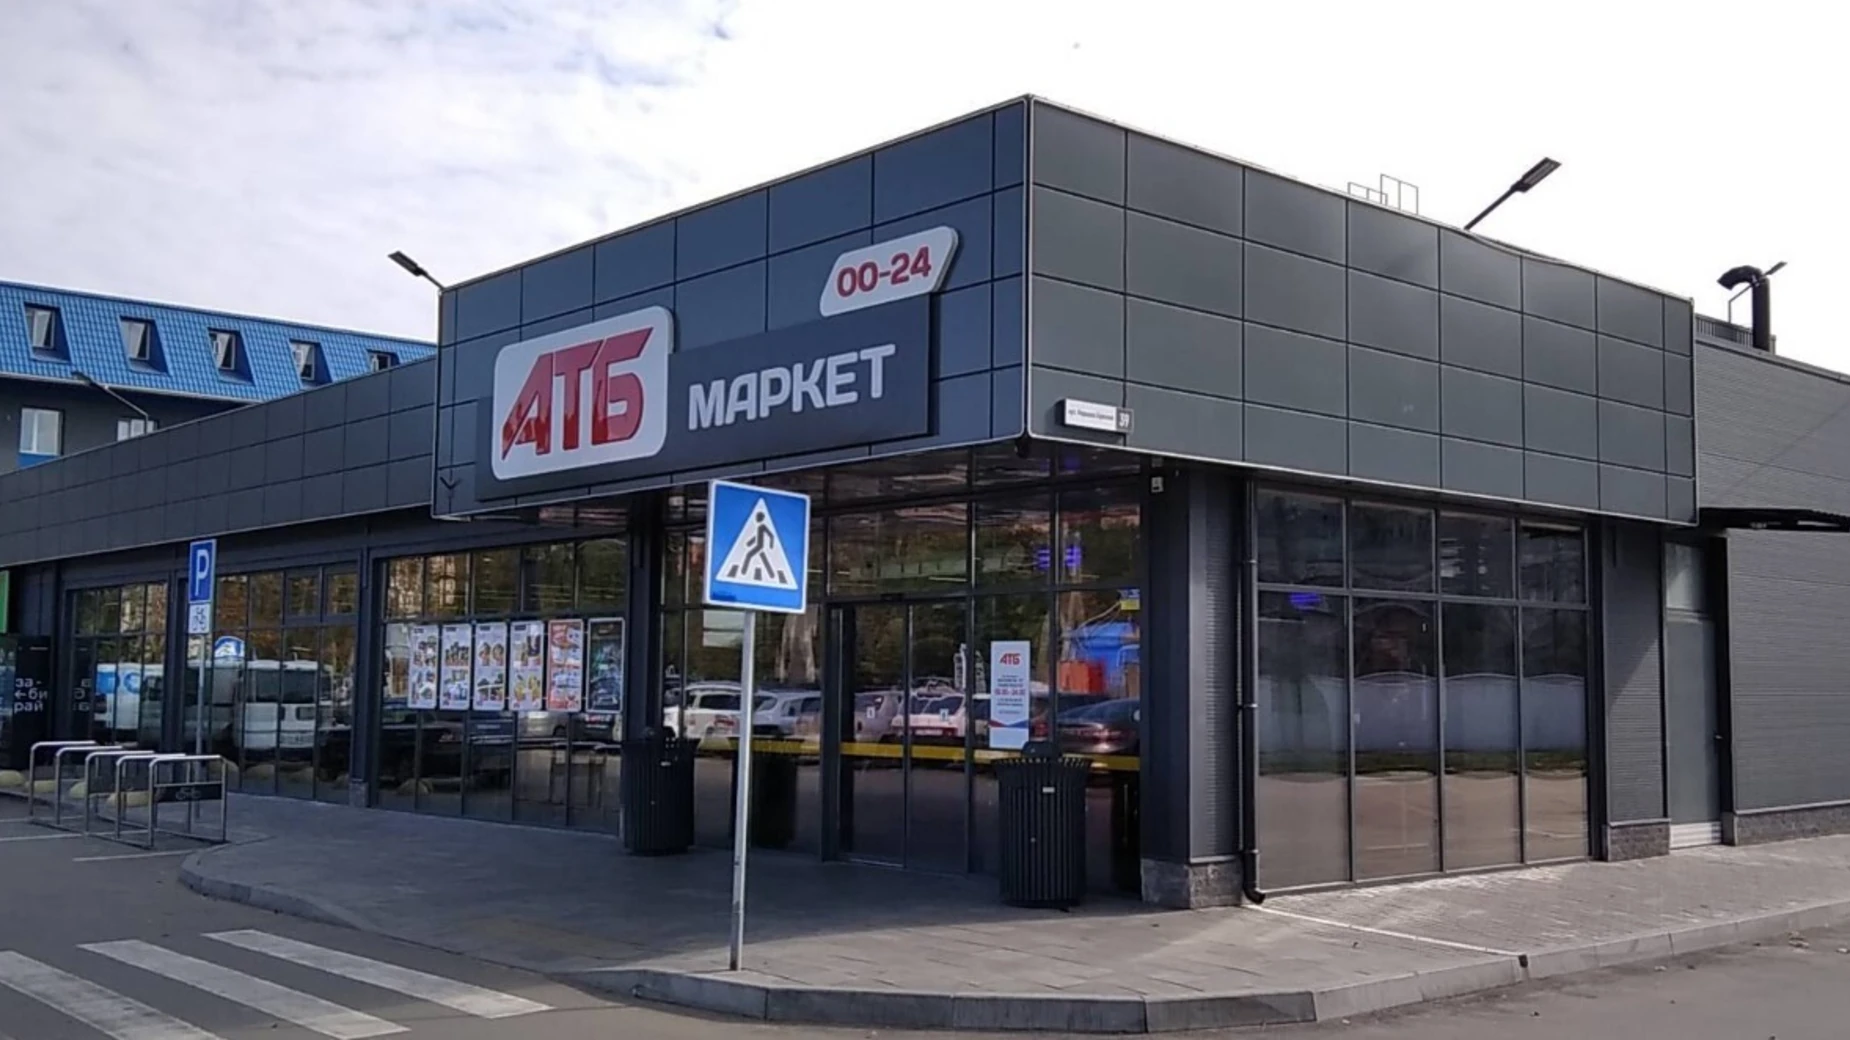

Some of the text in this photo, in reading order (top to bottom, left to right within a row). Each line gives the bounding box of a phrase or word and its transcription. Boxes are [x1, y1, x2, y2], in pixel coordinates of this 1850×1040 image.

[836, 245, 931, 298] 00-24
[501, 327, 654, 461] АТБ
[687, 344, 896, 431] МАРКЕТ
[194, 549, 210, 597] P
[999, 653, 1021, 666] АТБ
[14, 700, 43, 714] рай
